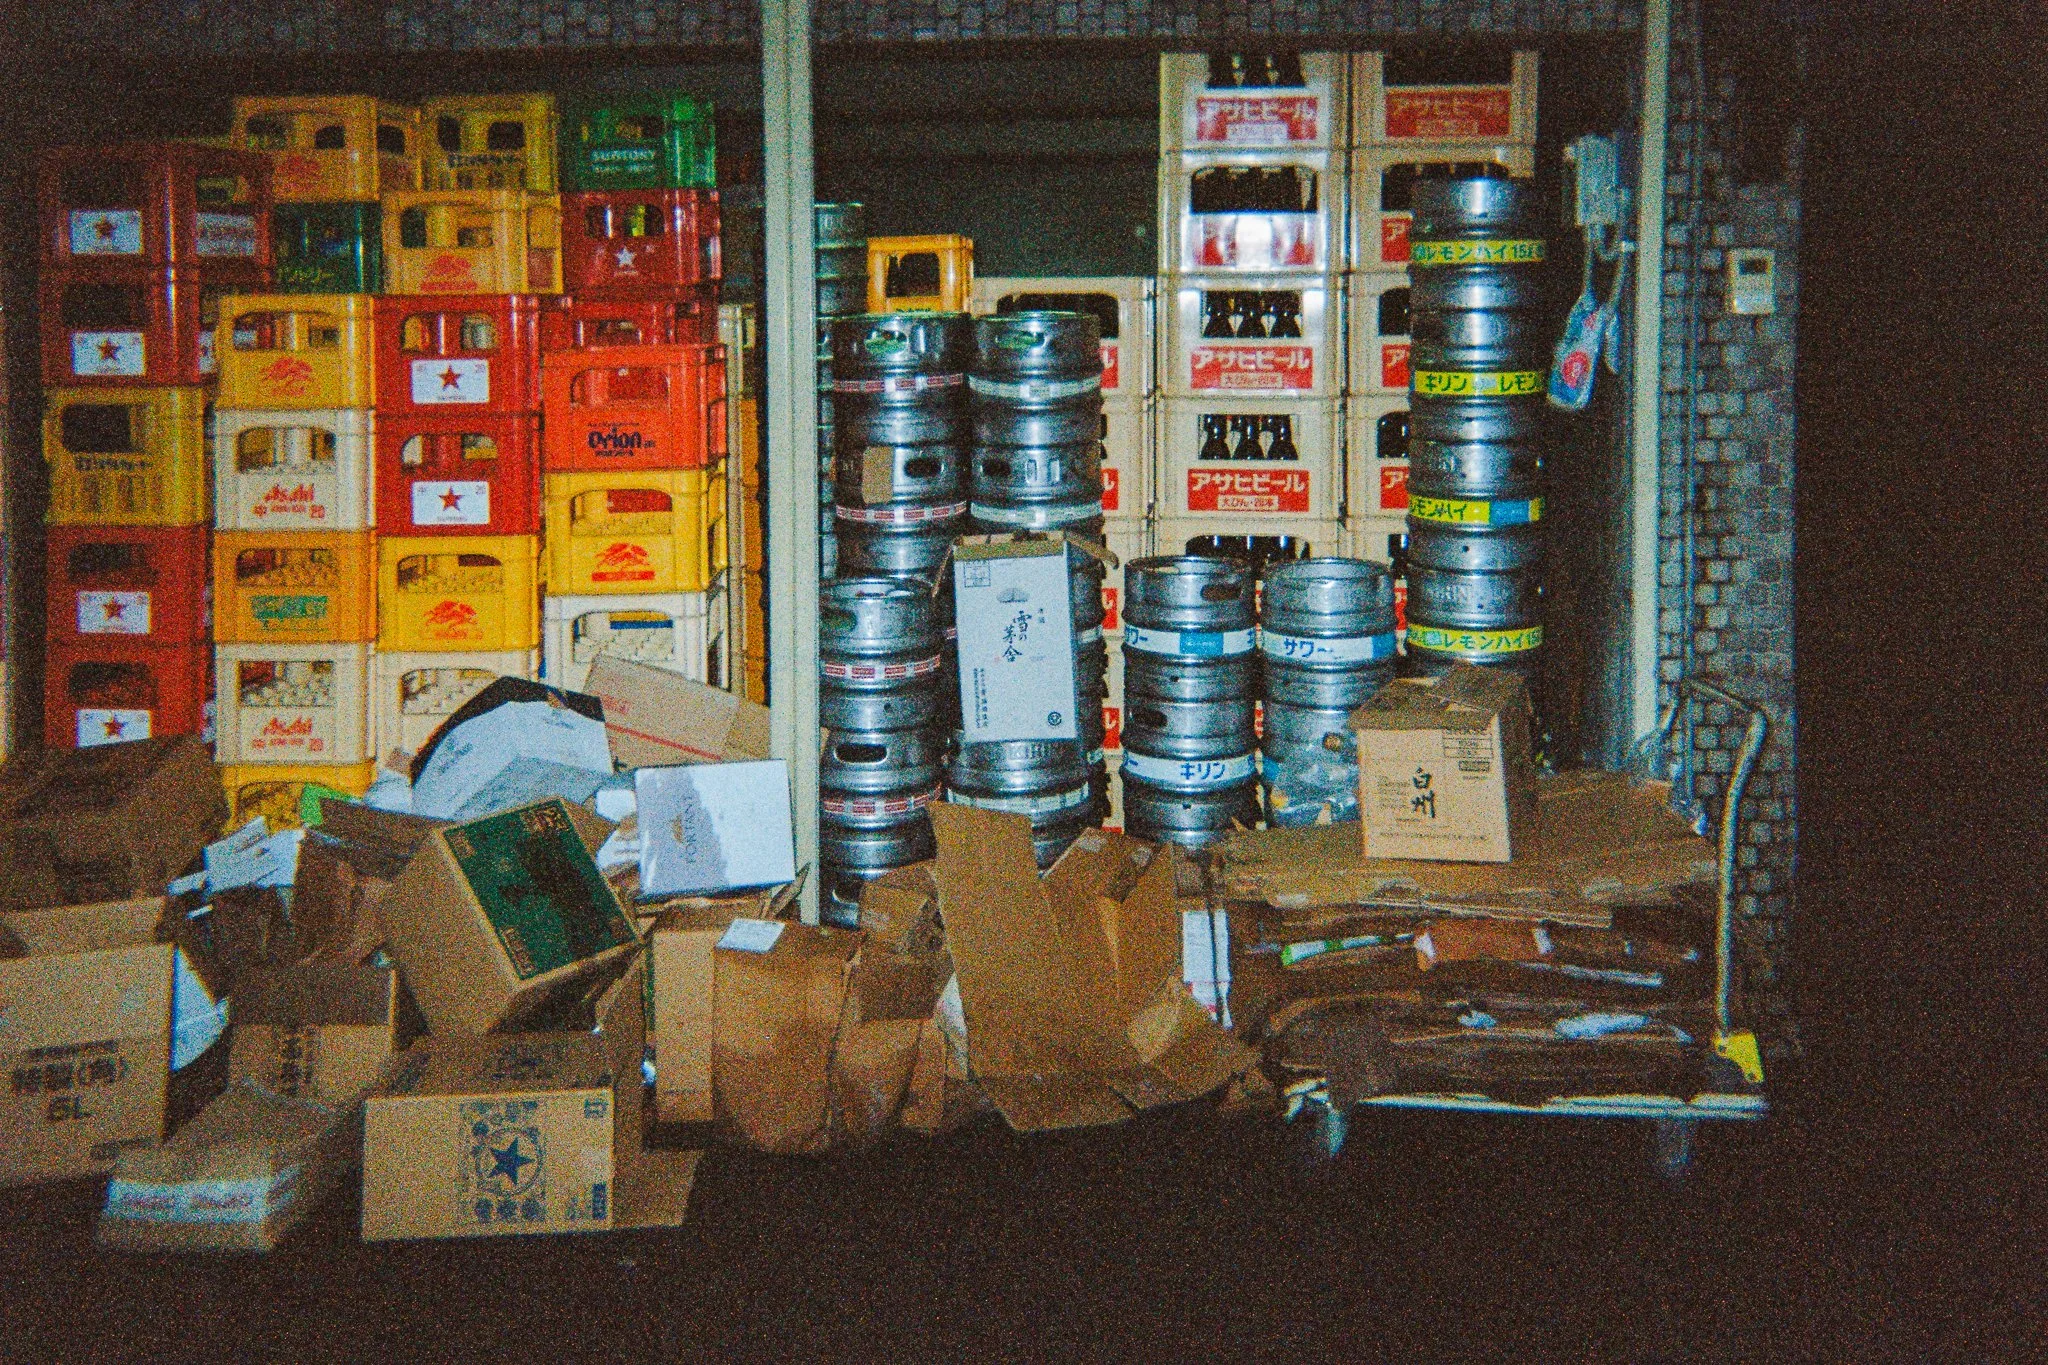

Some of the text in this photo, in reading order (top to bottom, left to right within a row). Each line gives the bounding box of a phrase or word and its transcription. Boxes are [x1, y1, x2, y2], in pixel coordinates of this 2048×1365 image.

[1191, 349, 1311, 370] アサヒビール
[1424, 373, 1468, 393] キリン
[1190, 470, 1306, 493] アサヒビール
[1283, 637, 1336, 658] サワー
[1180, 762, 1226, 780] キリン
[1410, 766, 1436, 819] 白州
